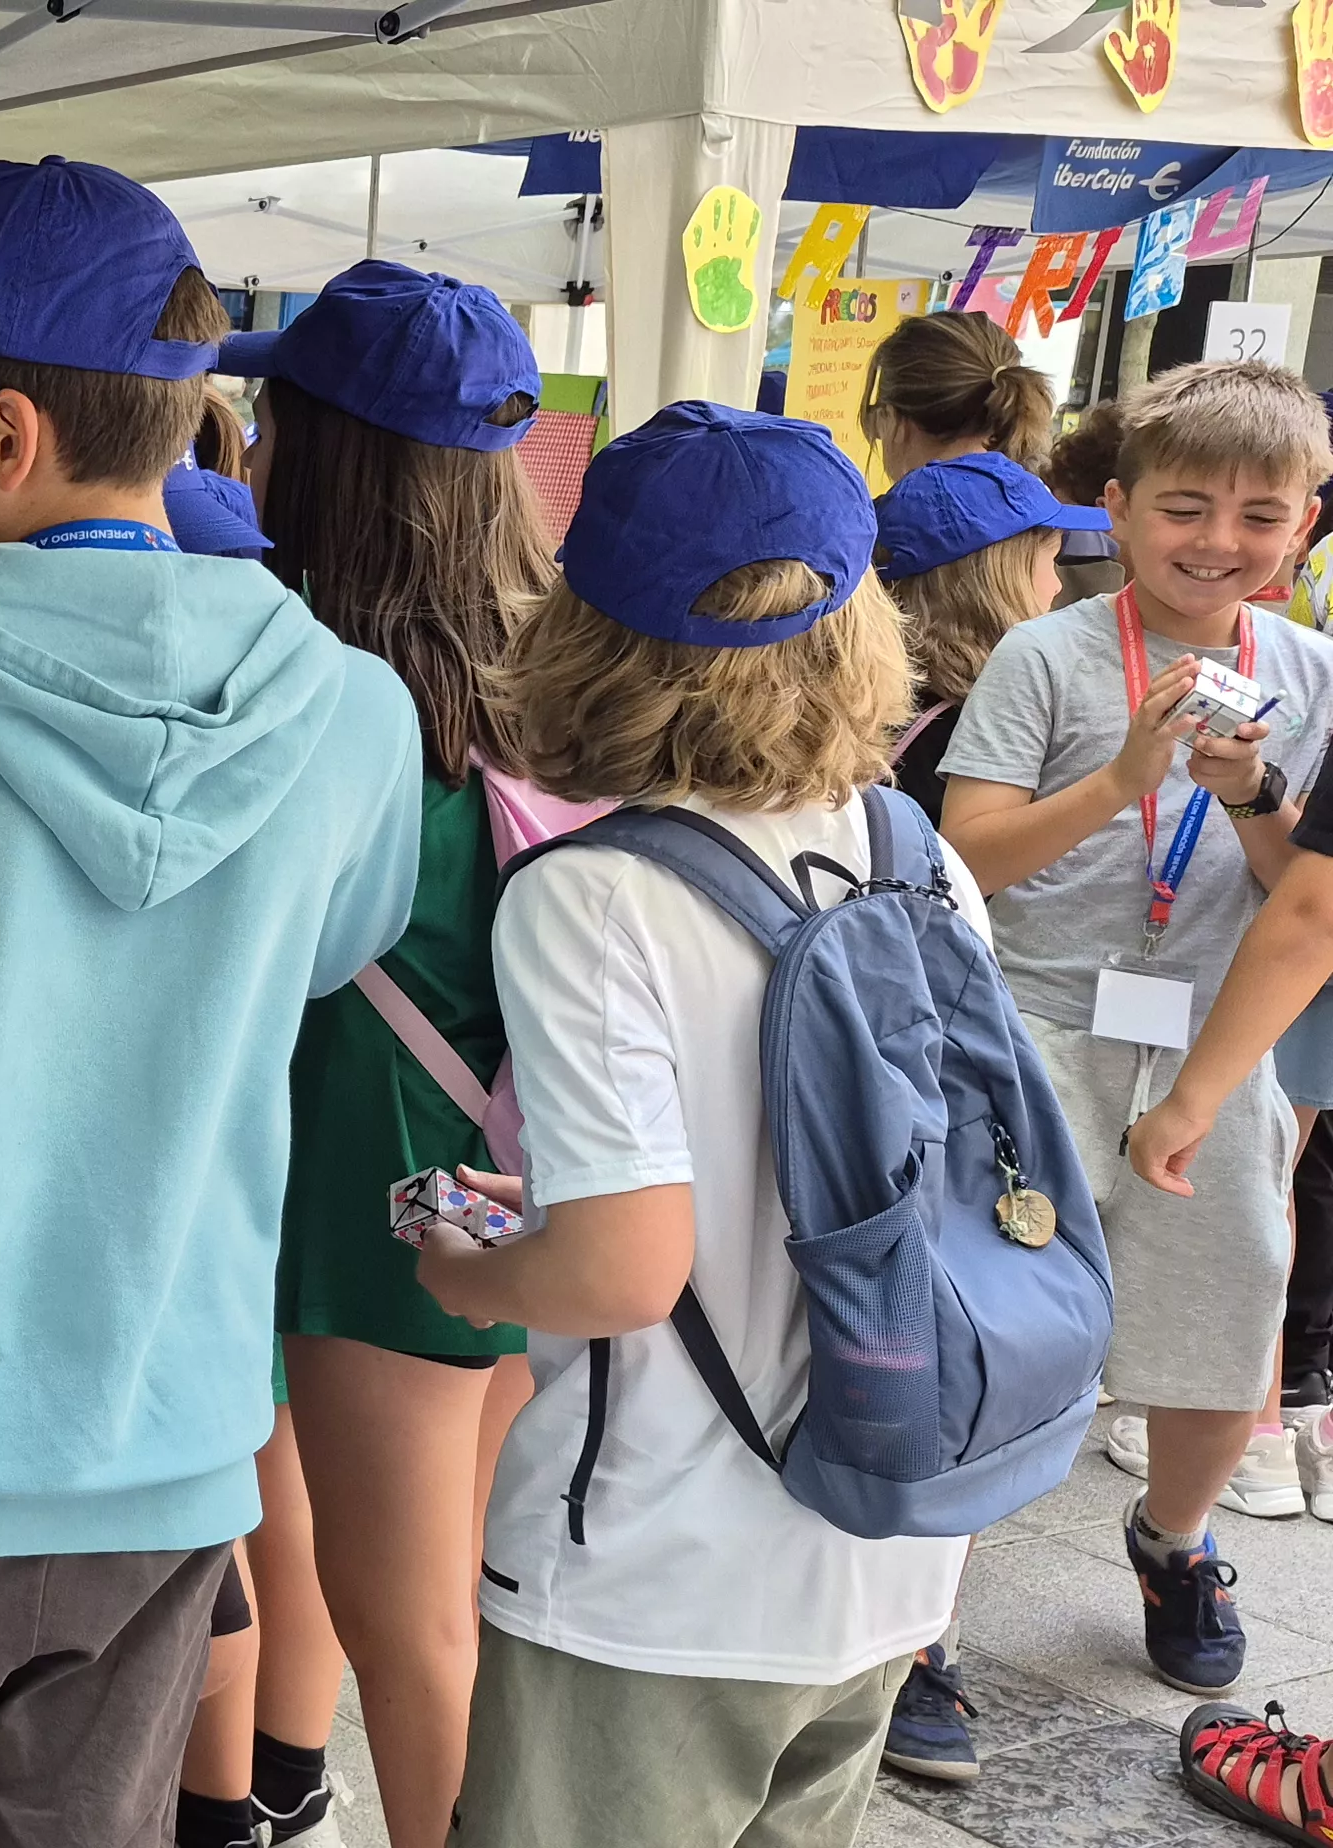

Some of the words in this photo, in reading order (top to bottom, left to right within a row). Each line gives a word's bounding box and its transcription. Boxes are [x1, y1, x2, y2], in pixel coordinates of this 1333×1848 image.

[1066, 139, 1141, 160] Fundación
[1230, 328, 1266, 360] 32
[40, 537, 48, 546] A
[51, 529, 136, 544] APRENDIENDO
